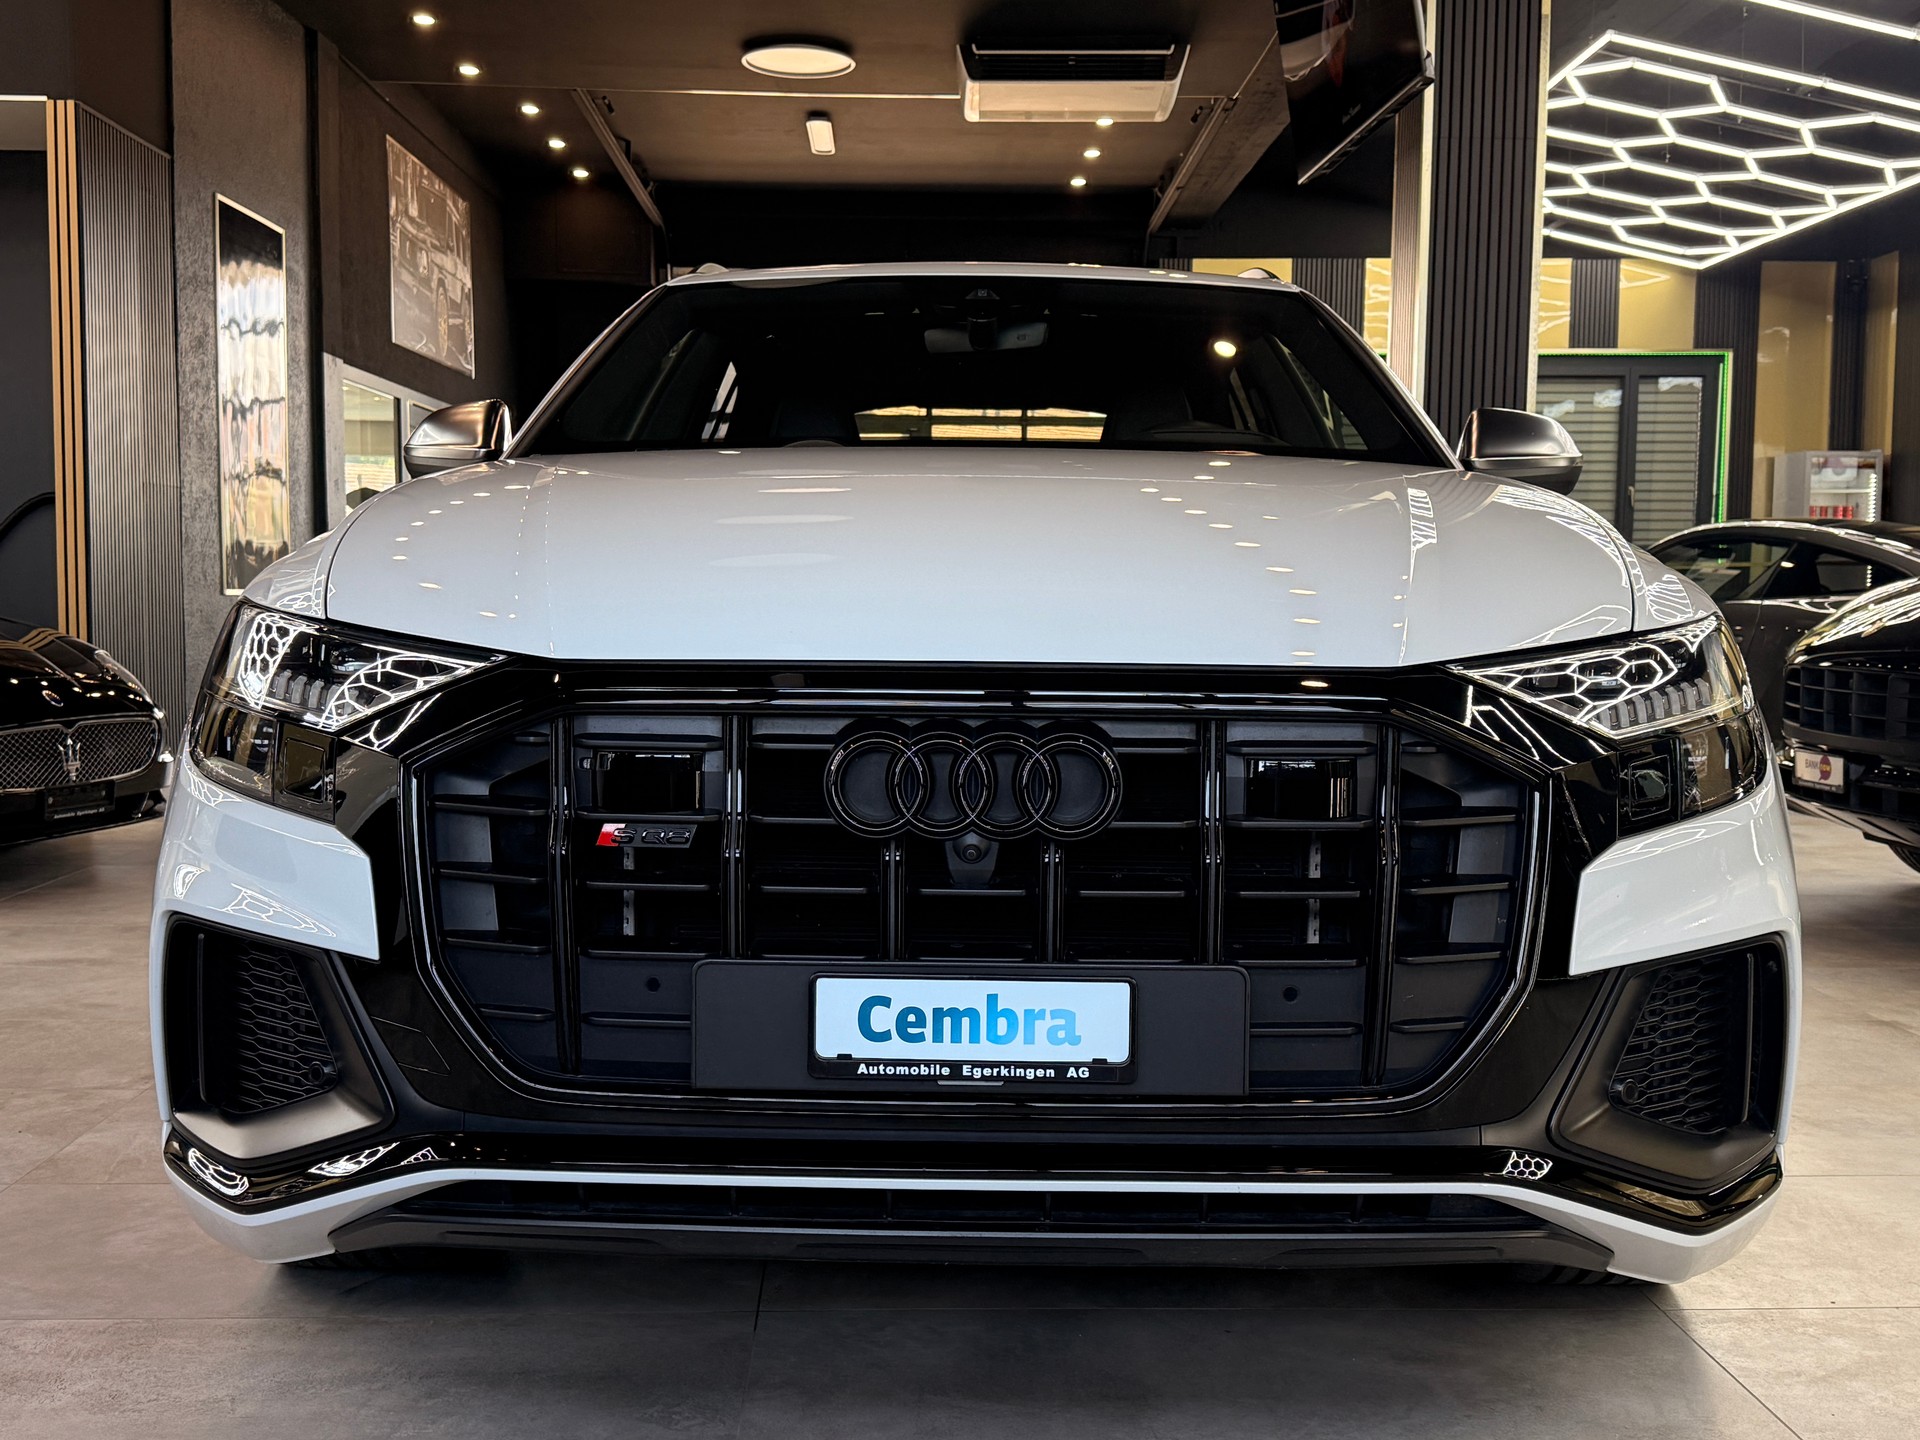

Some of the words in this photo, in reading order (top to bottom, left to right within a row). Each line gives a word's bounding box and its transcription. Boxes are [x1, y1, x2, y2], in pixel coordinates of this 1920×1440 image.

[857, 993, 1082, 1046] Cembra
[857, 1063, 951, 1076] Automobile
[962, 1064, 1055, 1079] Egerkingen
[1066, 1067, 1090, 1079] AG
